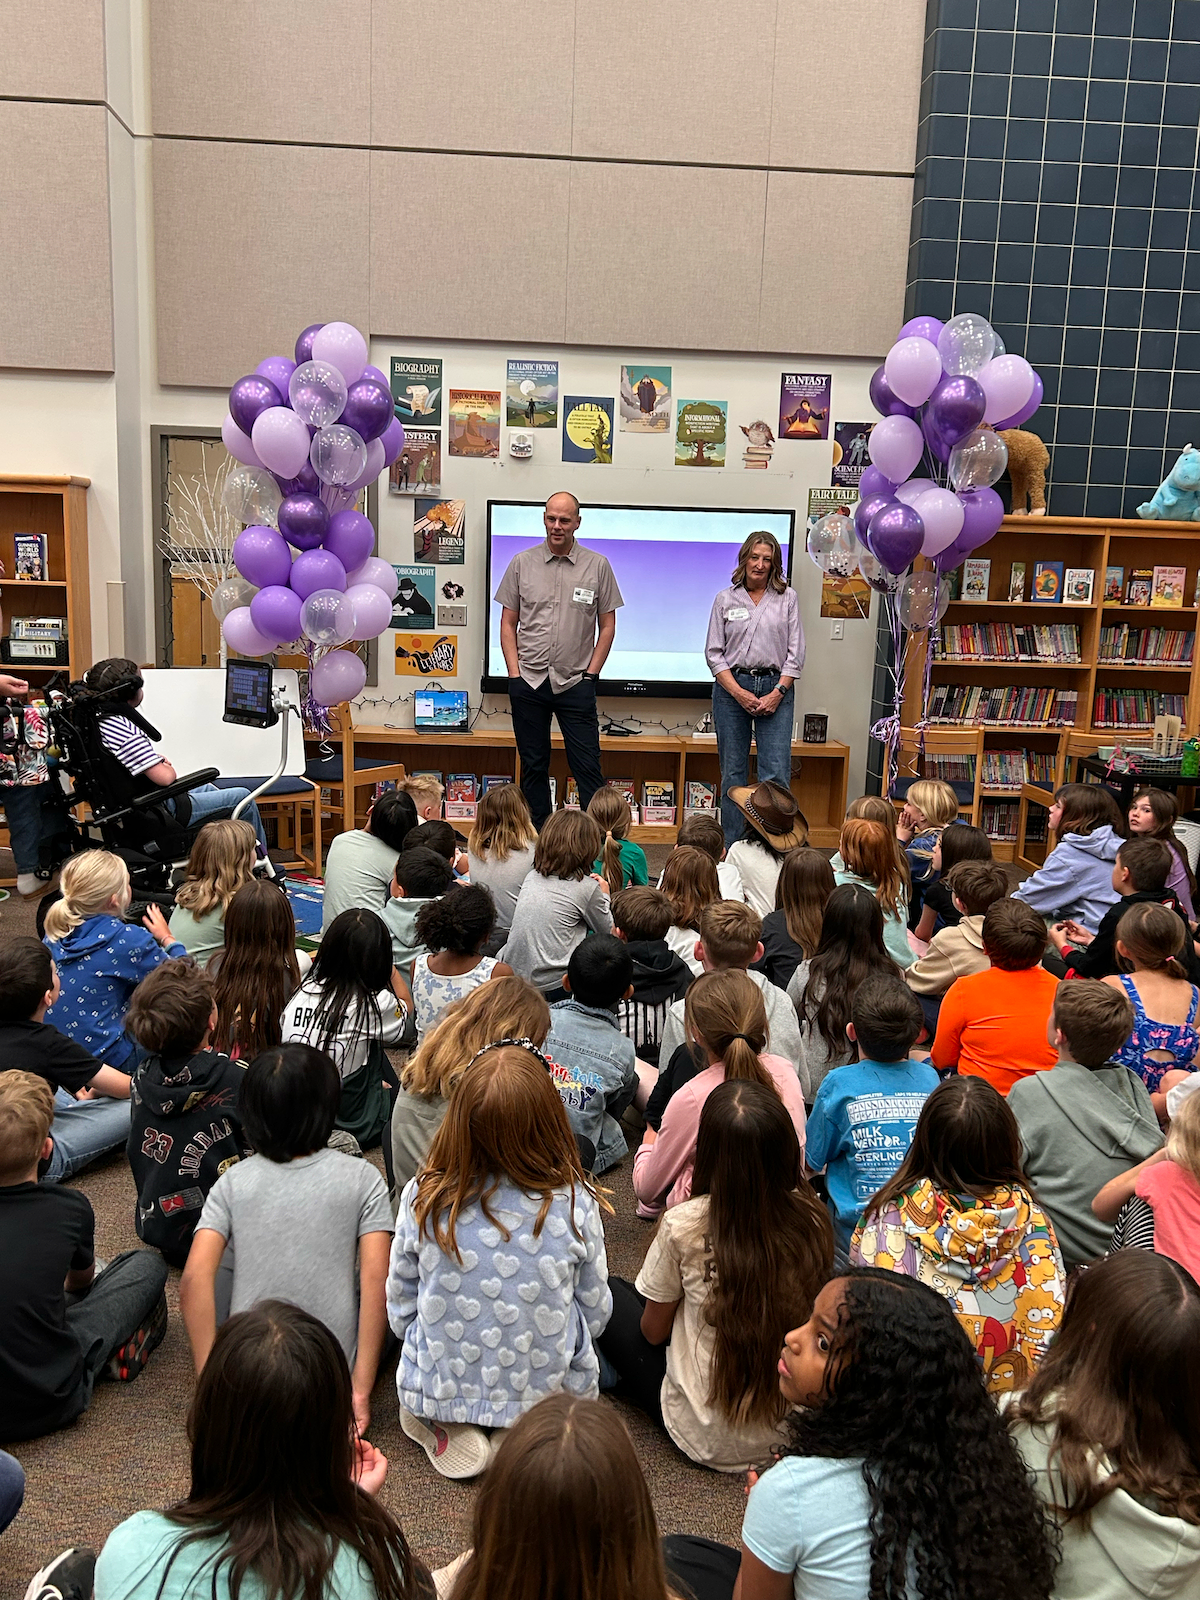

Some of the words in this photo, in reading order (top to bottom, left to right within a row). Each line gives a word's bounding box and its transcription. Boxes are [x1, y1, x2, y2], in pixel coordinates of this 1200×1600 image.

[394, 362, 440, 375] BIOGRAPHY
[508, 362, 536, 371] REALISTIC
[536, 363, 557, 372] FICTION
[784, 375, 828, 386] FANTASY
[451, 392, 479, 400] HISTORICAL
[480, 393, 500, 401] FICTION
[684, 414, 720, 422] INFORMATIONAL
[403, 431, 438, 441] YSTERY
[833, 465, 859, 473] SCIENCE
[811, 489, 836, 499] FAIRY
[836, 490, 857, 500] TALE
[438, 537, 464, 546] LEGEND
[395, 567, 435, 577] TOBIOGRAPHY
[420, 643, 454, 670] LITERARY
[569, 1065, 604, 1091] talk
[851, 1125, 884, 1141] MILK
[141, 1126, 174, 1165] 23
